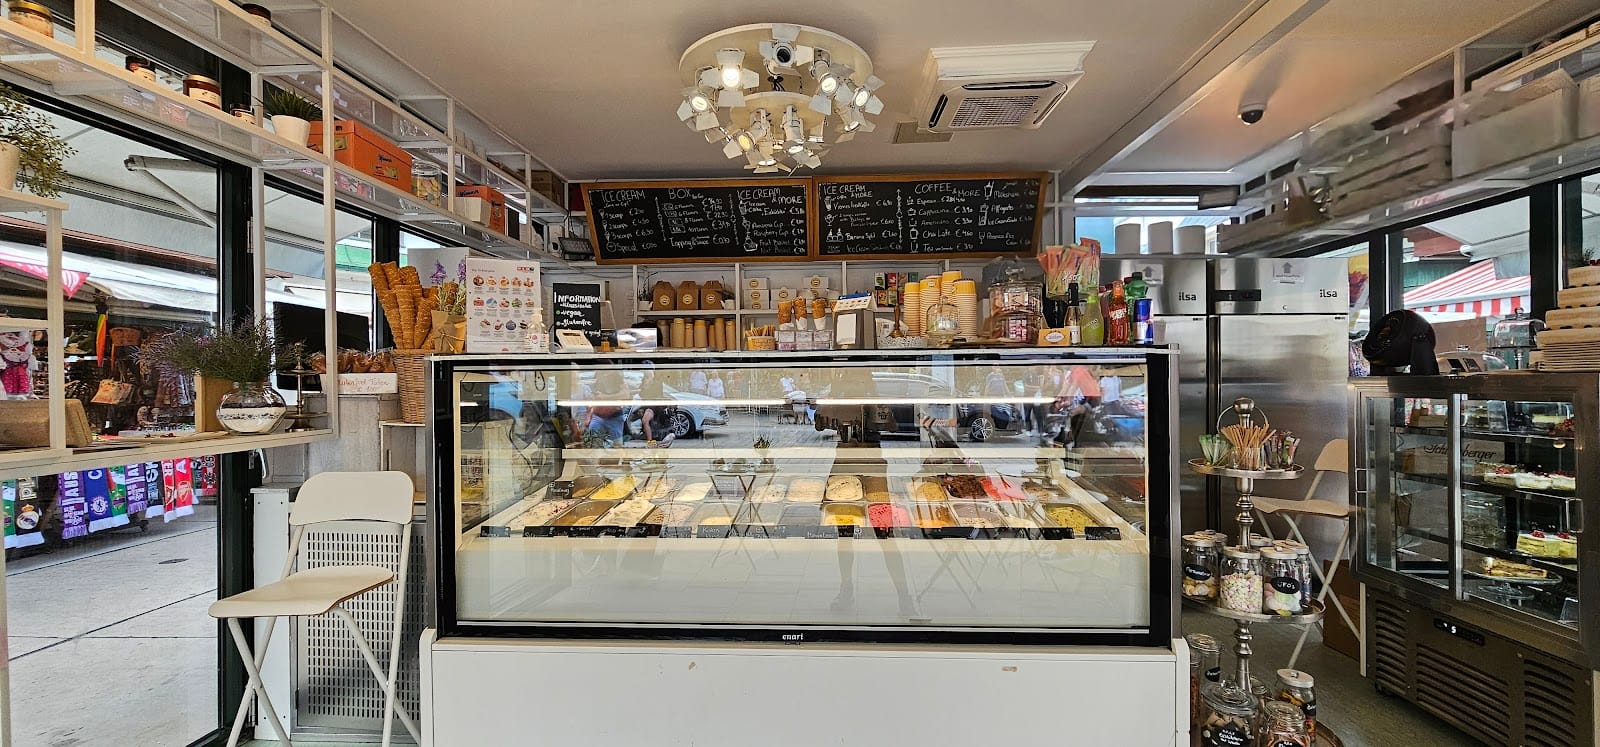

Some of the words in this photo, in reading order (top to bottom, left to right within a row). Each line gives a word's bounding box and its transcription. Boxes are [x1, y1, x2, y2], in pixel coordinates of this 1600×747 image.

[601, 190, 615, 202] ICE
[615, 188, 646, 202] CREAM
[667, 187, 691, 200] BOX
[736, 189, 752, 201] ICE
[752, 187, 781, 200] CREAM
[823, 185, 838, 196] ICE
[839, 183, 867, 194] CREAM
[855, 190, 873, 199] MORE
[914, 182, 953, 195] COFFEE
[957, 188, 981, 198] MORE
[777, 195, 803, 205] MORE
[553, 291, 601, 304] INFORMATION
[1178, 290, 1197, 301] ilsa
[1319, 288, 1338, 298] ilsa
